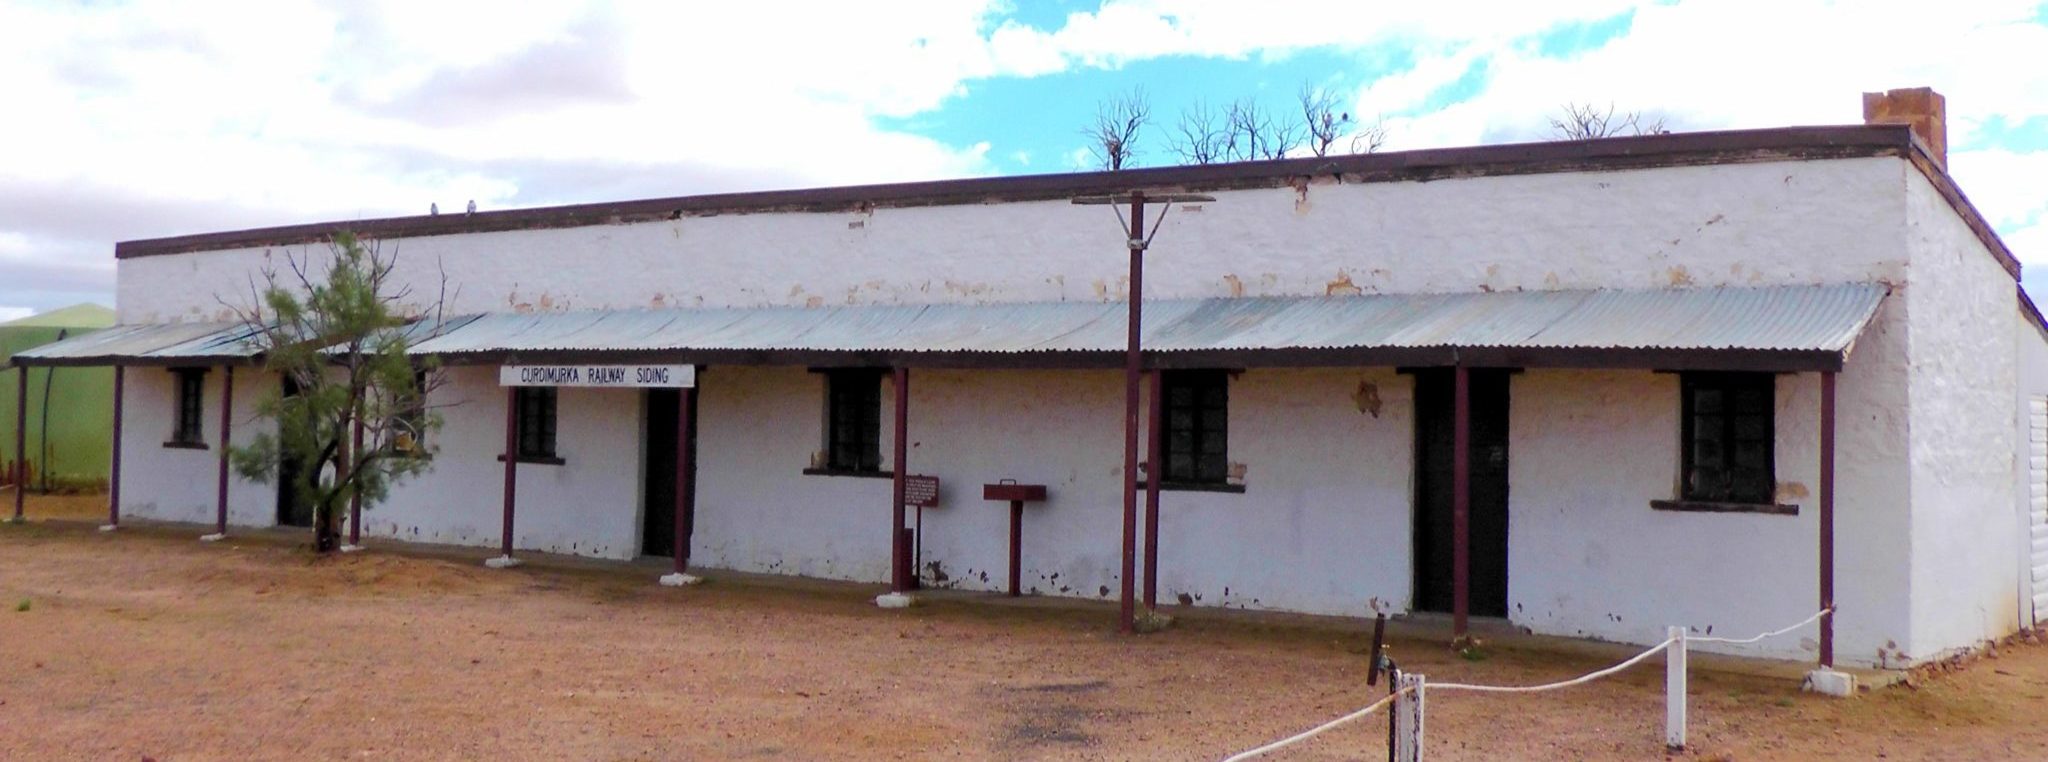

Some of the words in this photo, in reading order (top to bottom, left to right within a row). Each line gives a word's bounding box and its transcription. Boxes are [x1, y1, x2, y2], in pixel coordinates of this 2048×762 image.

[521, 367, 579, 383] CURDIMURKA
[588, 367, 625, 383] RAILWAY
[637, 367, 669, 383] SIDING
